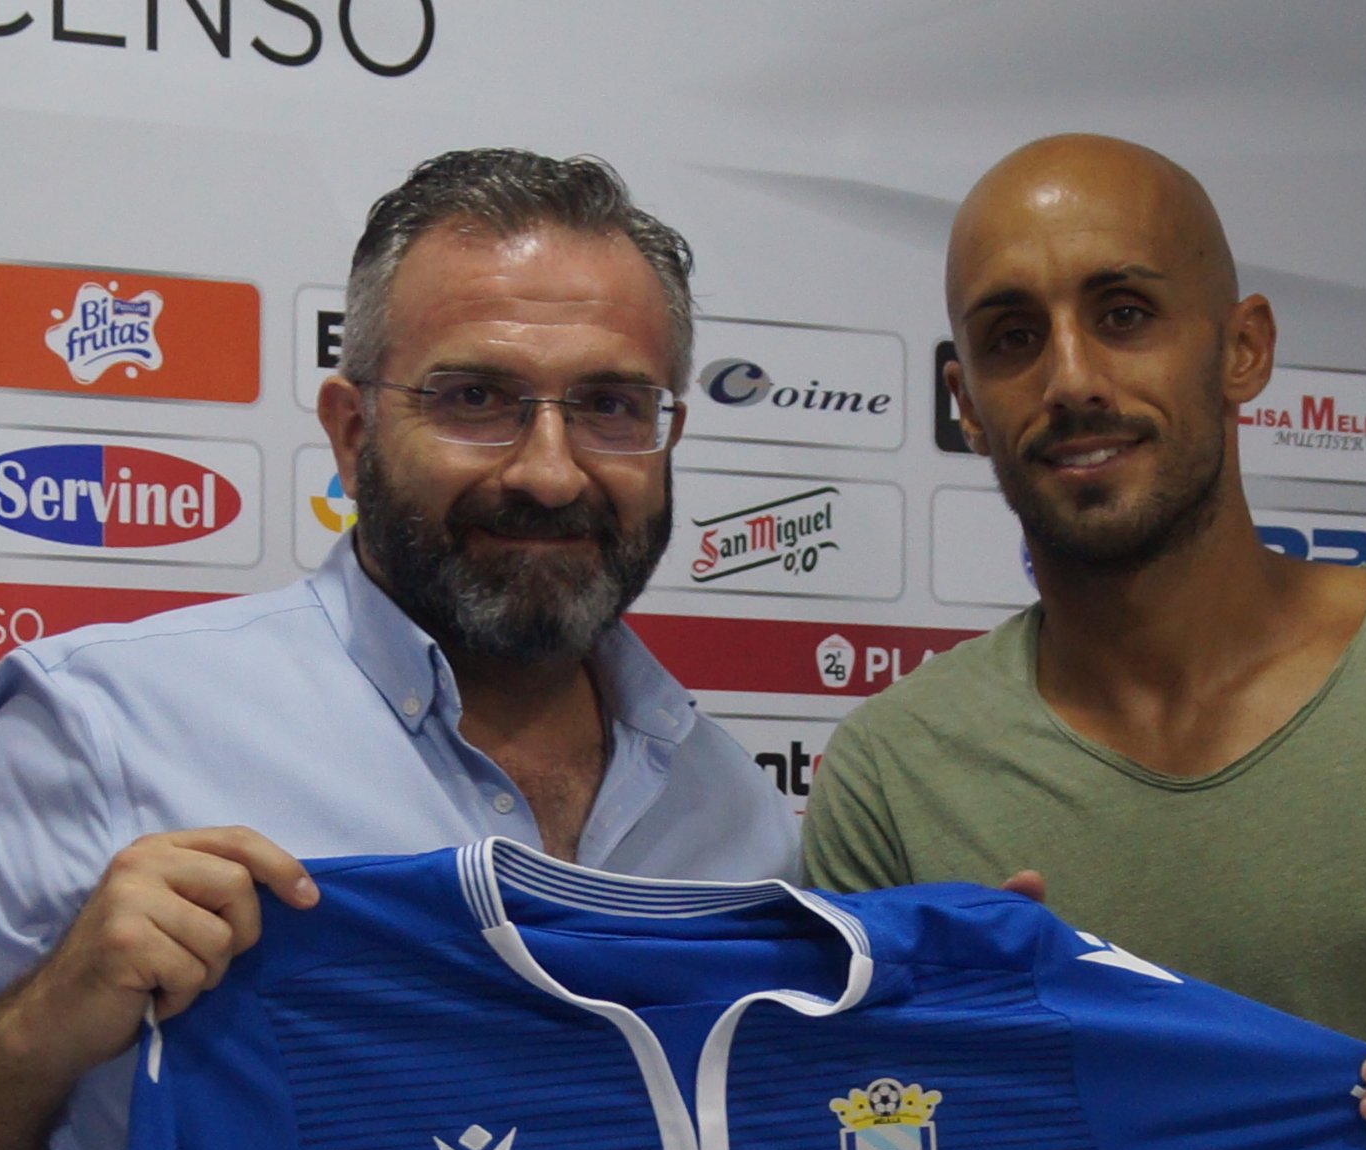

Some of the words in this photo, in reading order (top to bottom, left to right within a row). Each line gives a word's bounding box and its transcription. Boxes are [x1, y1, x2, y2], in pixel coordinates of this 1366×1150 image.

[81, 297, 108, 331] Bi
[66, 320, 150, 361] frutas
[708, 362, 891, 414] Coime
[692, 529, 747, 573] San
[745, 502, 832, 552] Miguel
